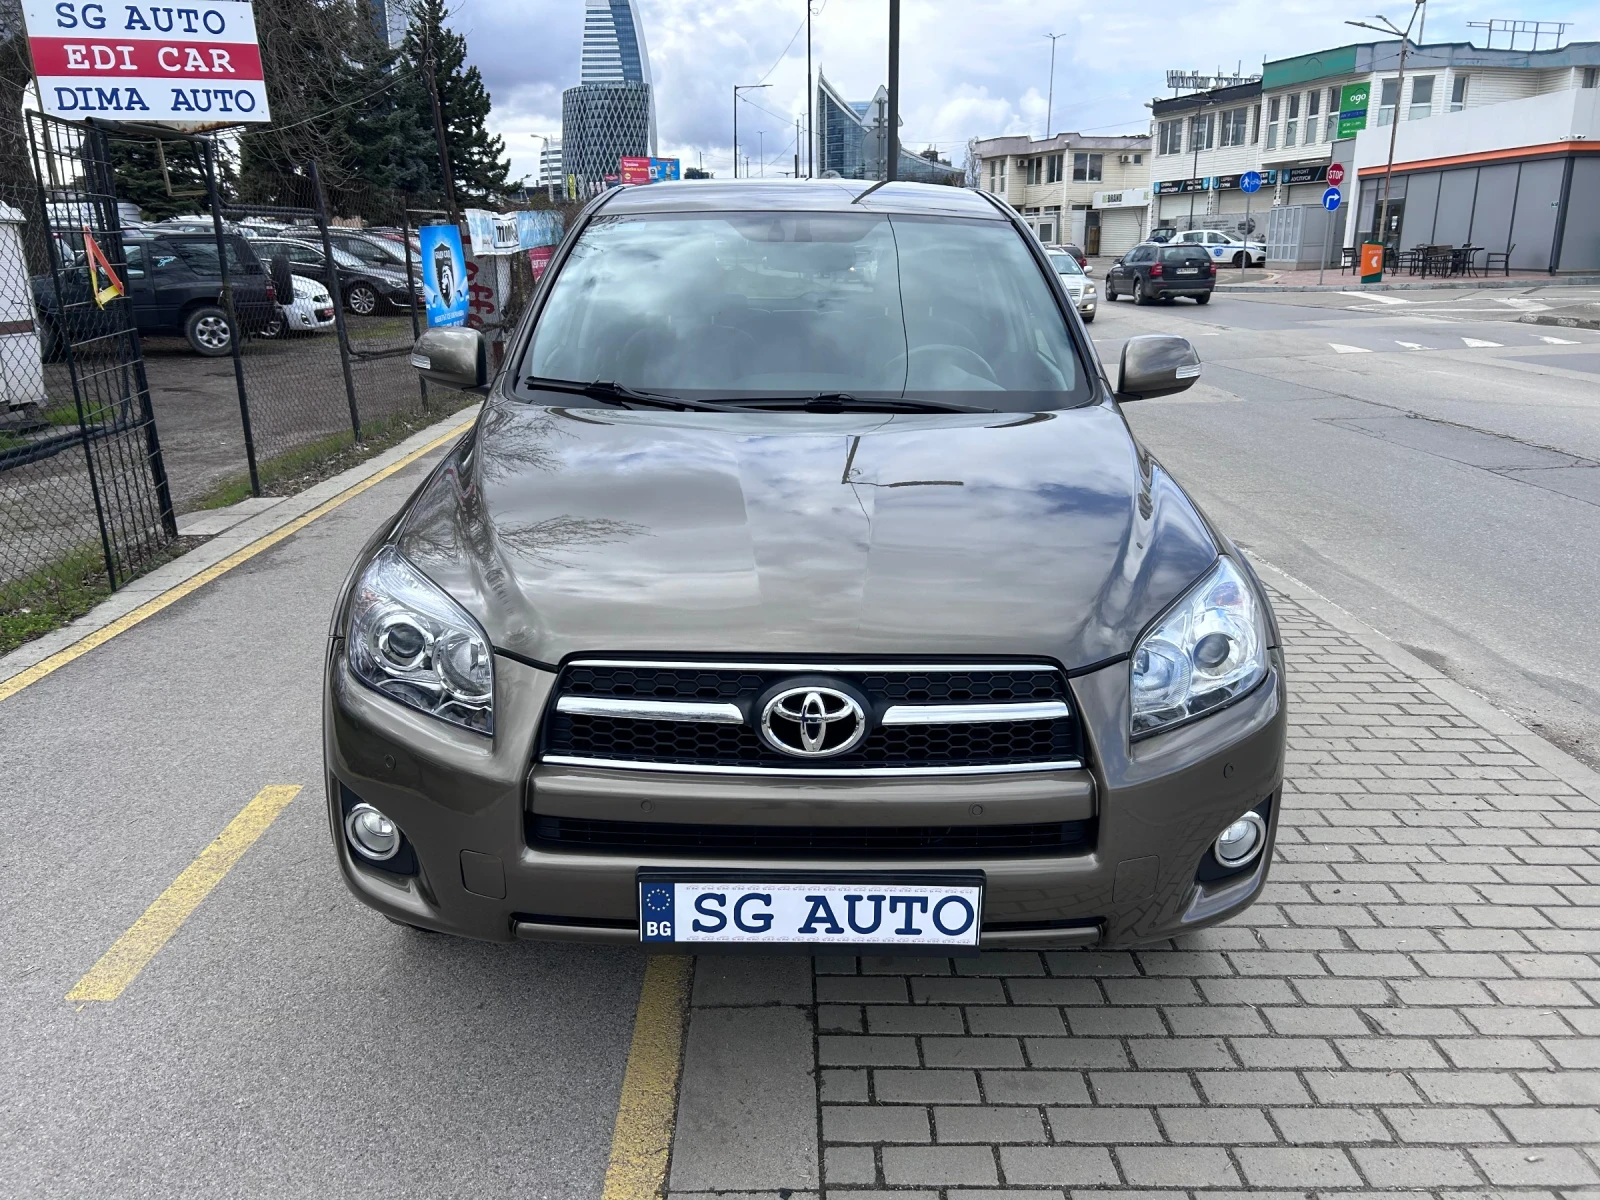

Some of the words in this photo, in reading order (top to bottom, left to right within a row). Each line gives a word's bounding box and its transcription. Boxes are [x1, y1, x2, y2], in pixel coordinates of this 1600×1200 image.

[55, 2, 106, 29] SG
[124, 5, 226, 34] AUTO
[63, 44, 138, 71] EDI
[157, 46, 236, 73] CAR
[53, 86, 150, 111] DIMA
[170, 88, 256, 113] AUTO
[1328, 170, 1344, 180] STOP
[692, 892, 775, 934] SG
[797, 894, 975, 937] AUTO
[646, 921, 672, 937] BG
